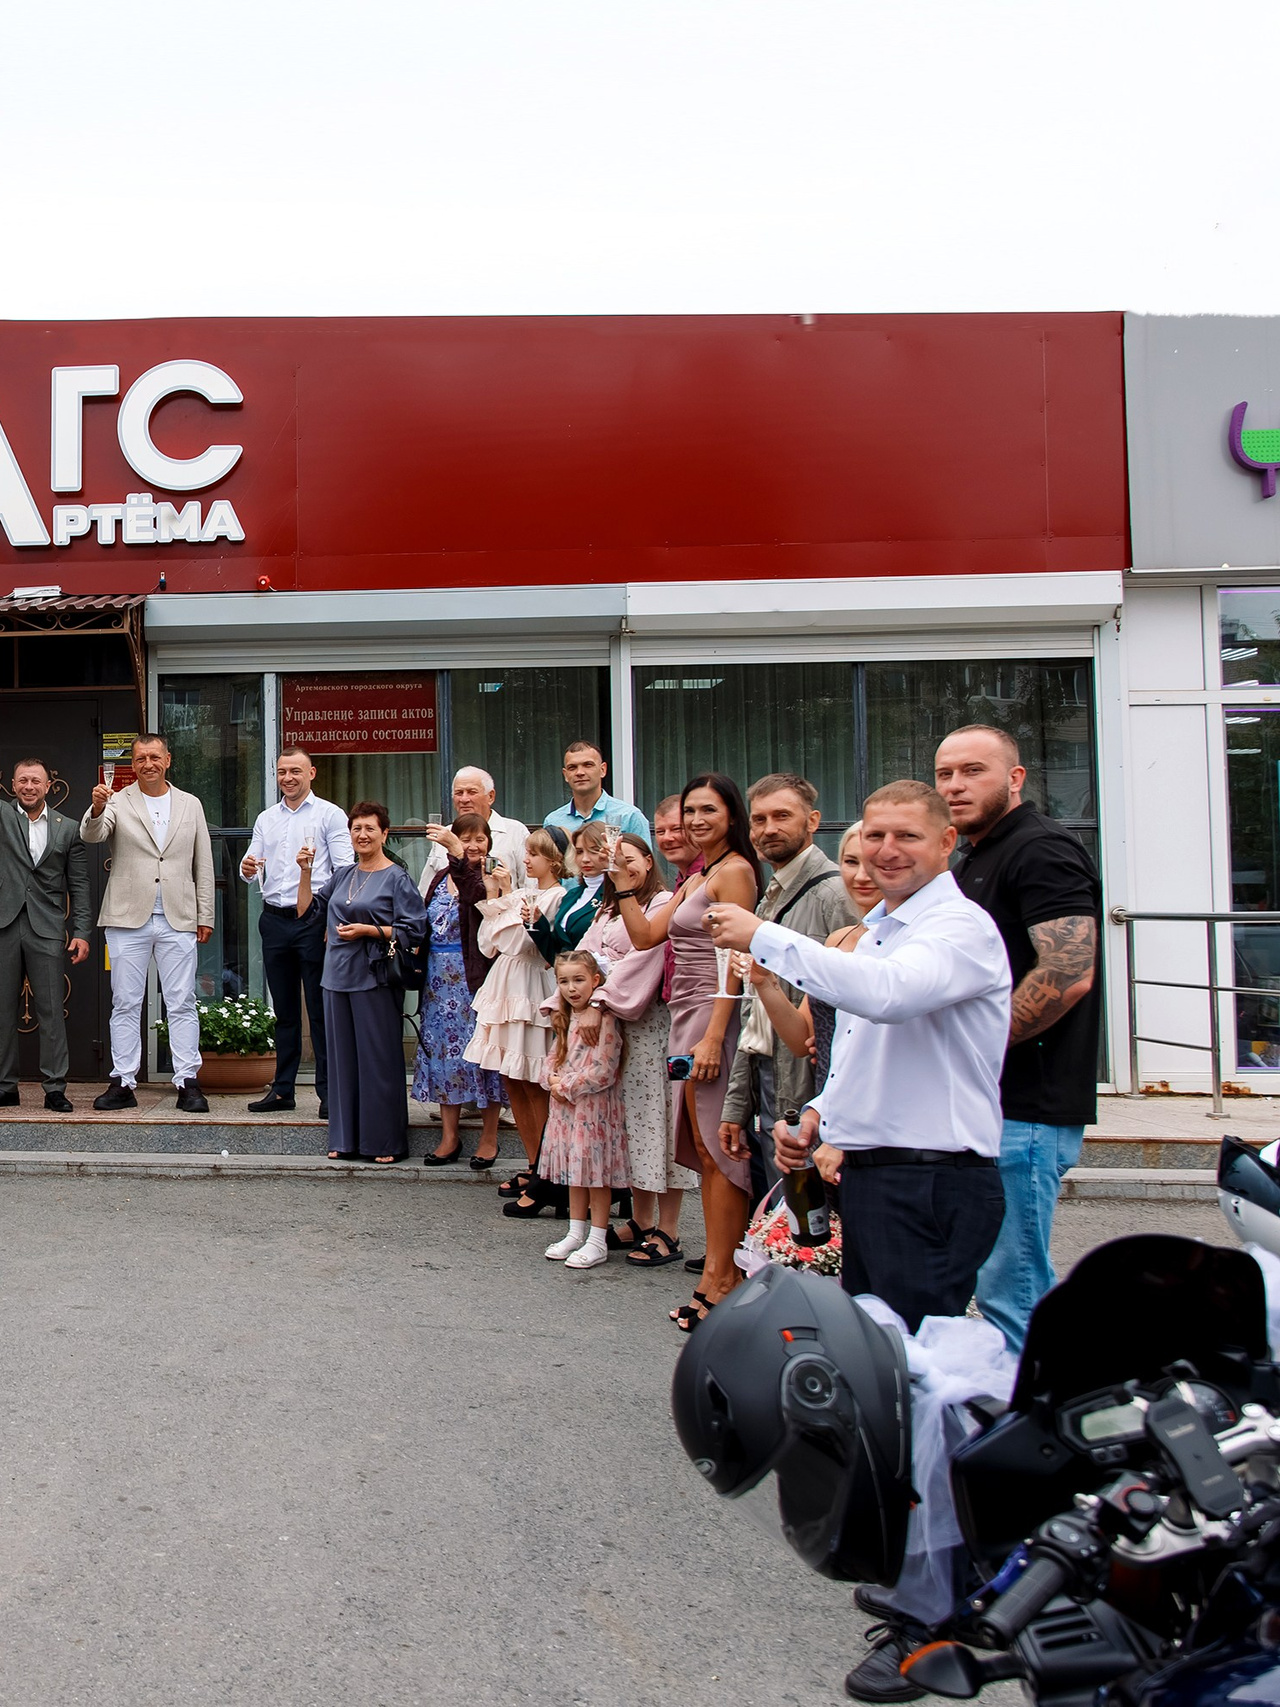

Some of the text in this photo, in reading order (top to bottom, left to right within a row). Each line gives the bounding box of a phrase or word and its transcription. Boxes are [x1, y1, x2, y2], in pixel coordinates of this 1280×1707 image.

[295, 684, 349, 692] Артемовского
[350, 683, 394, 691] городского
[285, 707, 434, 725] Управление записи актов
[285, 728, 434, 745] гражданского состояния
